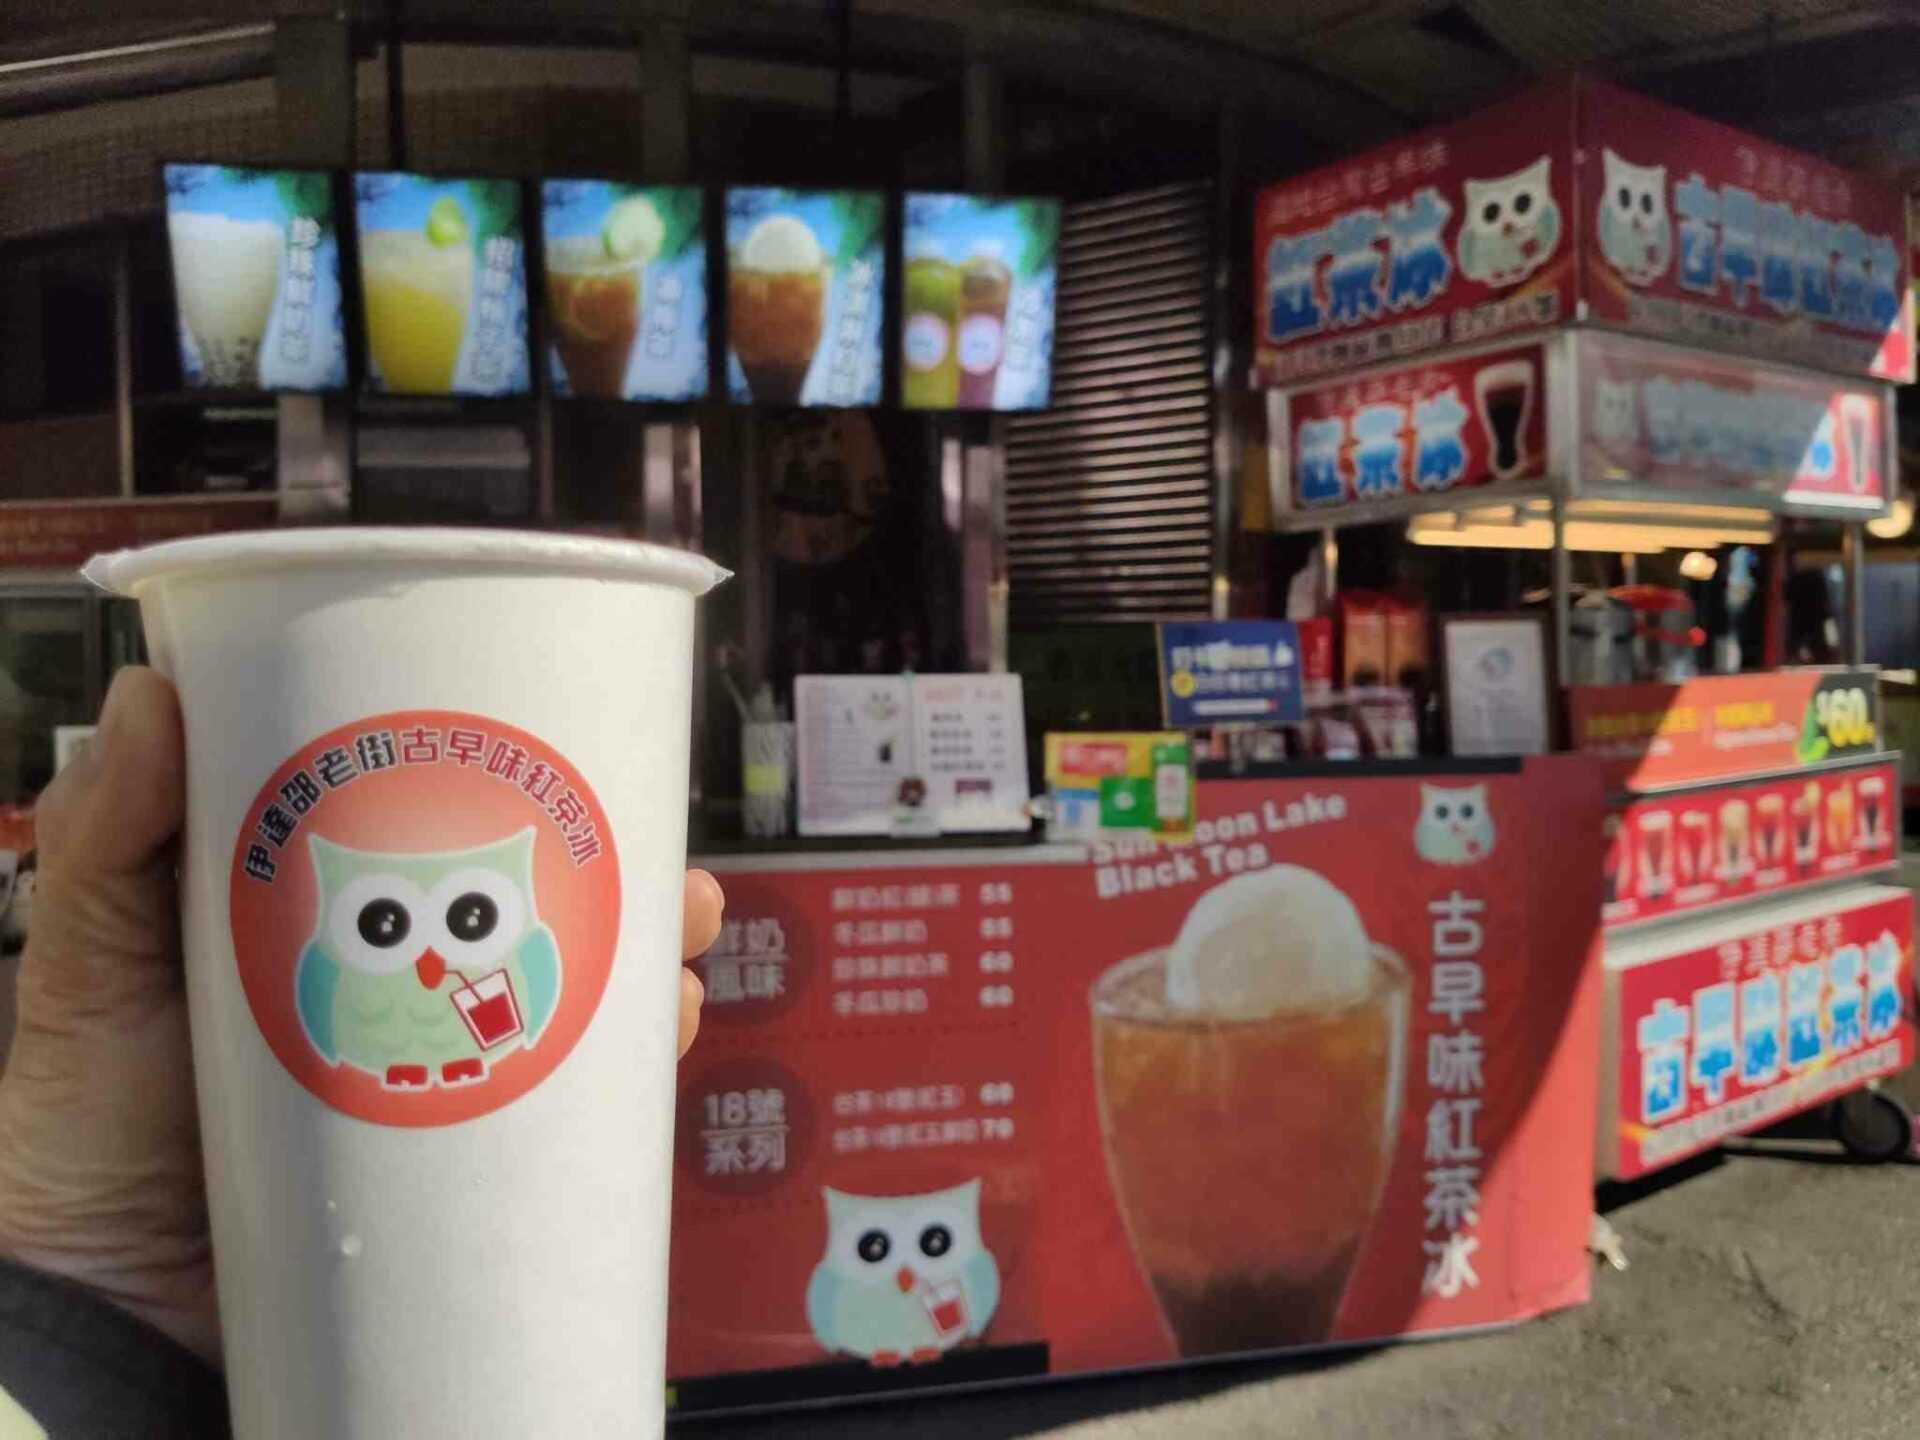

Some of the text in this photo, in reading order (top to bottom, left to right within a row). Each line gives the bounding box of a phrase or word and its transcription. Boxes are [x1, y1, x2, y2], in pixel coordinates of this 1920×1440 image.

[1263, 793, 1347, 832] Lake
[1095, 842, 1268, 898] Black Tea
[1636, 929, 1902, 1125] 古早味紅茶冰
[1423, 890, 1485, 1298] 古早味紅茶冰
[704, 1132, 786, 1175] 系列
